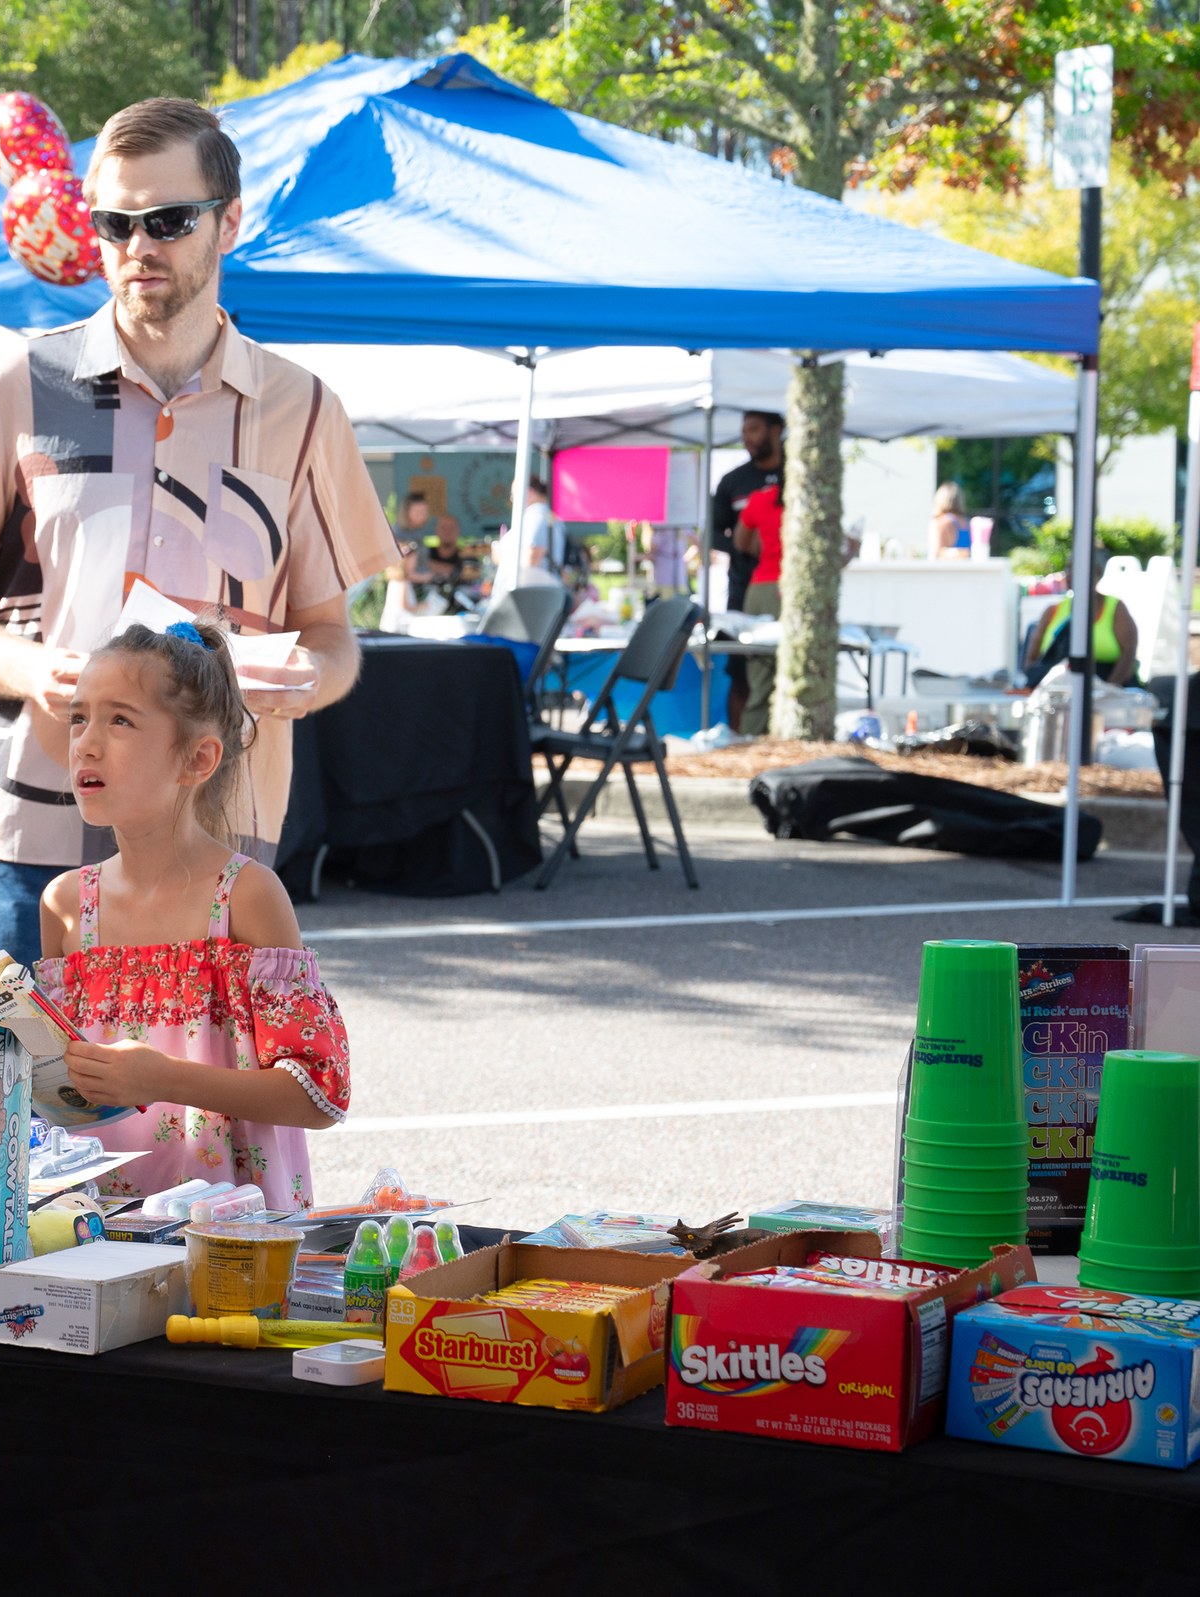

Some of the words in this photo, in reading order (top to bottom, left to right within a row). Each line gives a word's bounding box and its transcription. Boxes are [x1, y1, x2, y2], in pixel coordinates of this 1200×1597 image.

[1040, 976, 1072, 992] Strikes
[1033, 1005, 1088, 1017] Rock'em
[945, 1054, 983, 1067] Stars
[22, 1307, 41, 1317] Stars
[315, 1306, 332, 1314] glance
[390, 1300, 415, 1315] 36
[390, 1314, 415, 1324] COUNT
[415, 1328, 538, 1371] Starburst
[680, 1340, 827, 1386] Skittles
[1025, 1359, 1056, 1373] bars
[1057, 1361, 1076, 1375] 60
[553, 1368, 586, 1378] ORIGINAL
[1023, 1361, 1155, 1409] AIRHEADS
[677, 1401, 696, 1420] 36
[696, 1403, 718, 1414] COUNT
[696, 1412, 719, 1423] PACKS
[789, 1414, 798, 1422] 36
[805, 1415, 817, 1424] 2.17
[819, 1417, 828, 1425] OZ
[855, 1420, 891, 1433] PACKAGES
[756, 1419, 770, 1428] NET
[771, 1420, 782, 1430] WT
[803, 1424, 812, 1434] OZ
[814, 1426, 821, 1436] (4
[822, 1426, 836, 1436] LBS
[856, 1430, 868, 1441] OZ)
